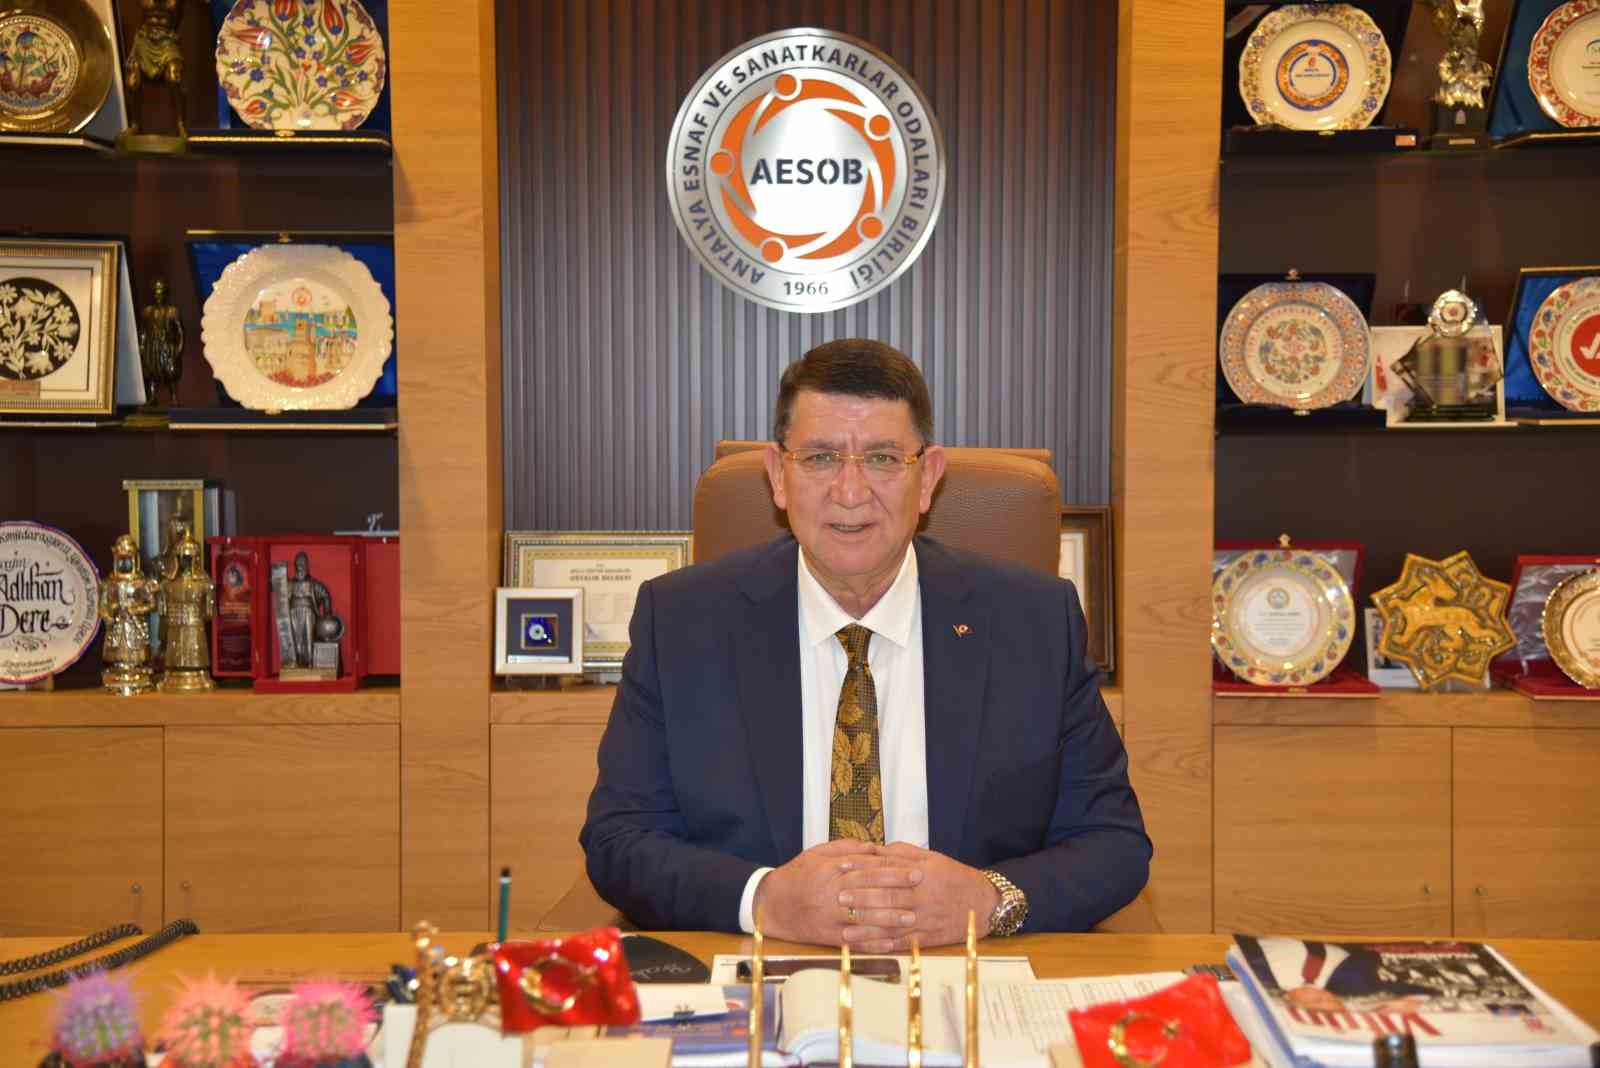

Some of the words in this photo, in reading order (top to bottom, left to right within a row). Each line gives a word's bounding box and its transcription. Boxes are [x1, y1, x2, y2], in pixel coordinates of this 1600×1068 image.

[703, 80, 732, 108] VE
[732, 45, 899, 99] SANATKARLAR
[683, 113, 708, 192] ESNAF
[750, 158, 863, 185] AESOB
[897, 102, 930, 209] ODALARI
[688, 199, 766, 284] ANTALYA
[783, 281, 829, 296] 1966
[0, 603, 51, 638] Dere
